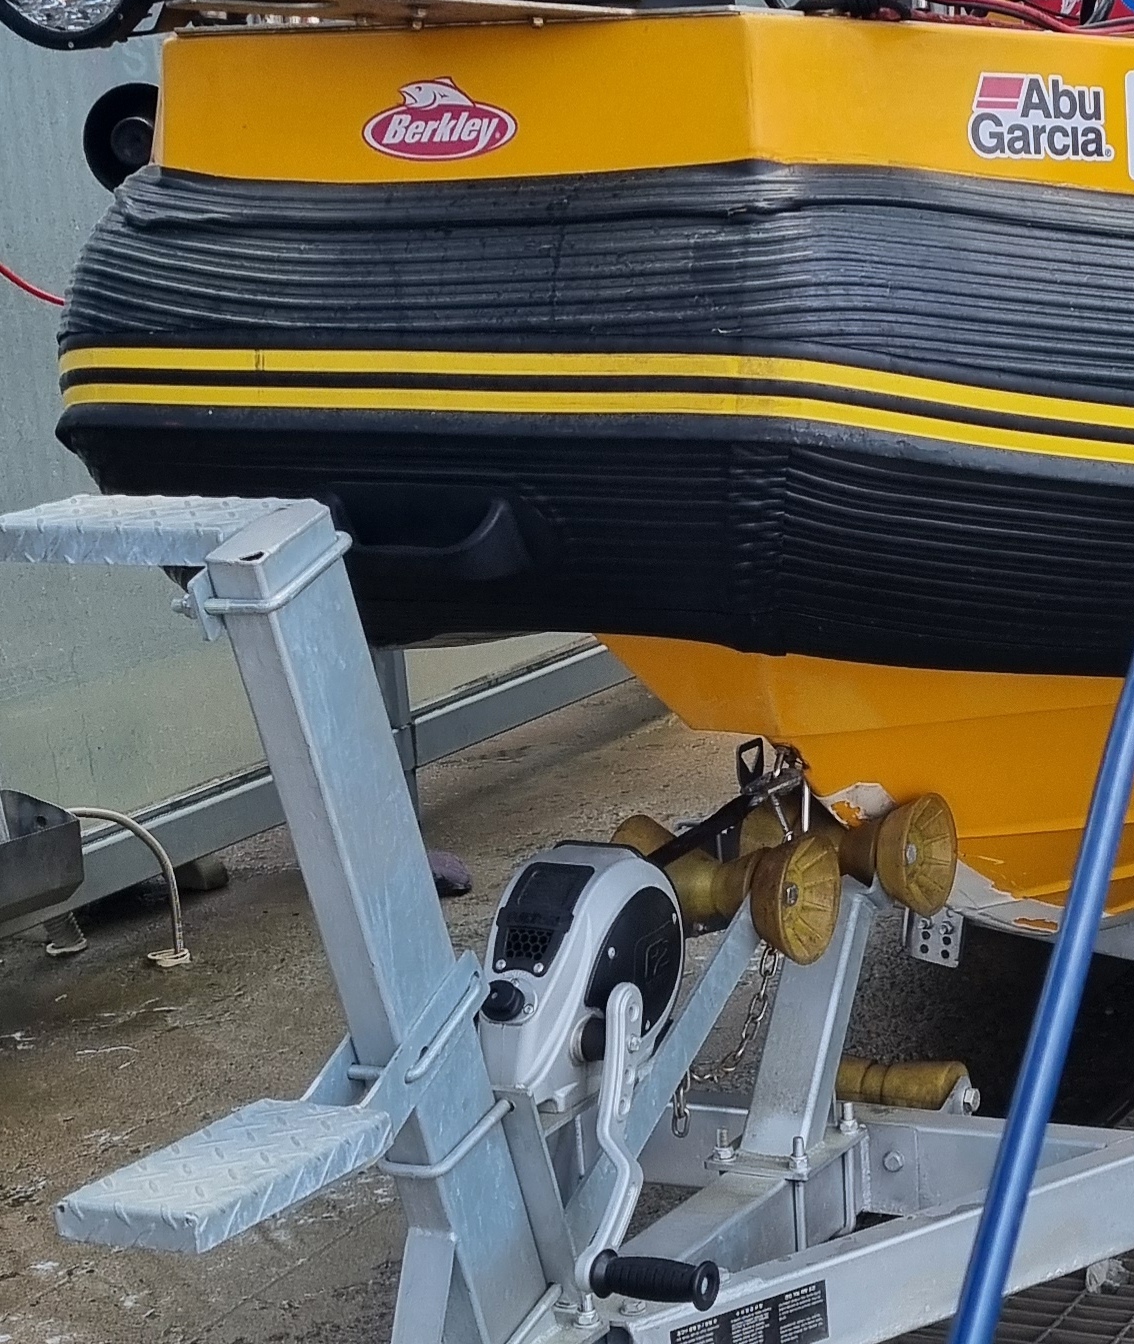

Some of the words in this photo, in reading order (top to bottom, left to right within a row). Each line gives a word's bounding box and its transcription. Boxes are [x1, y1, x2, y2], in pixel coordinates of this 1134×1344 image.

[1020, 78, 1101, 121] Abu
[382, 112, 500, 151] Berkley
[971, 112, 1105, 157] Garcia
